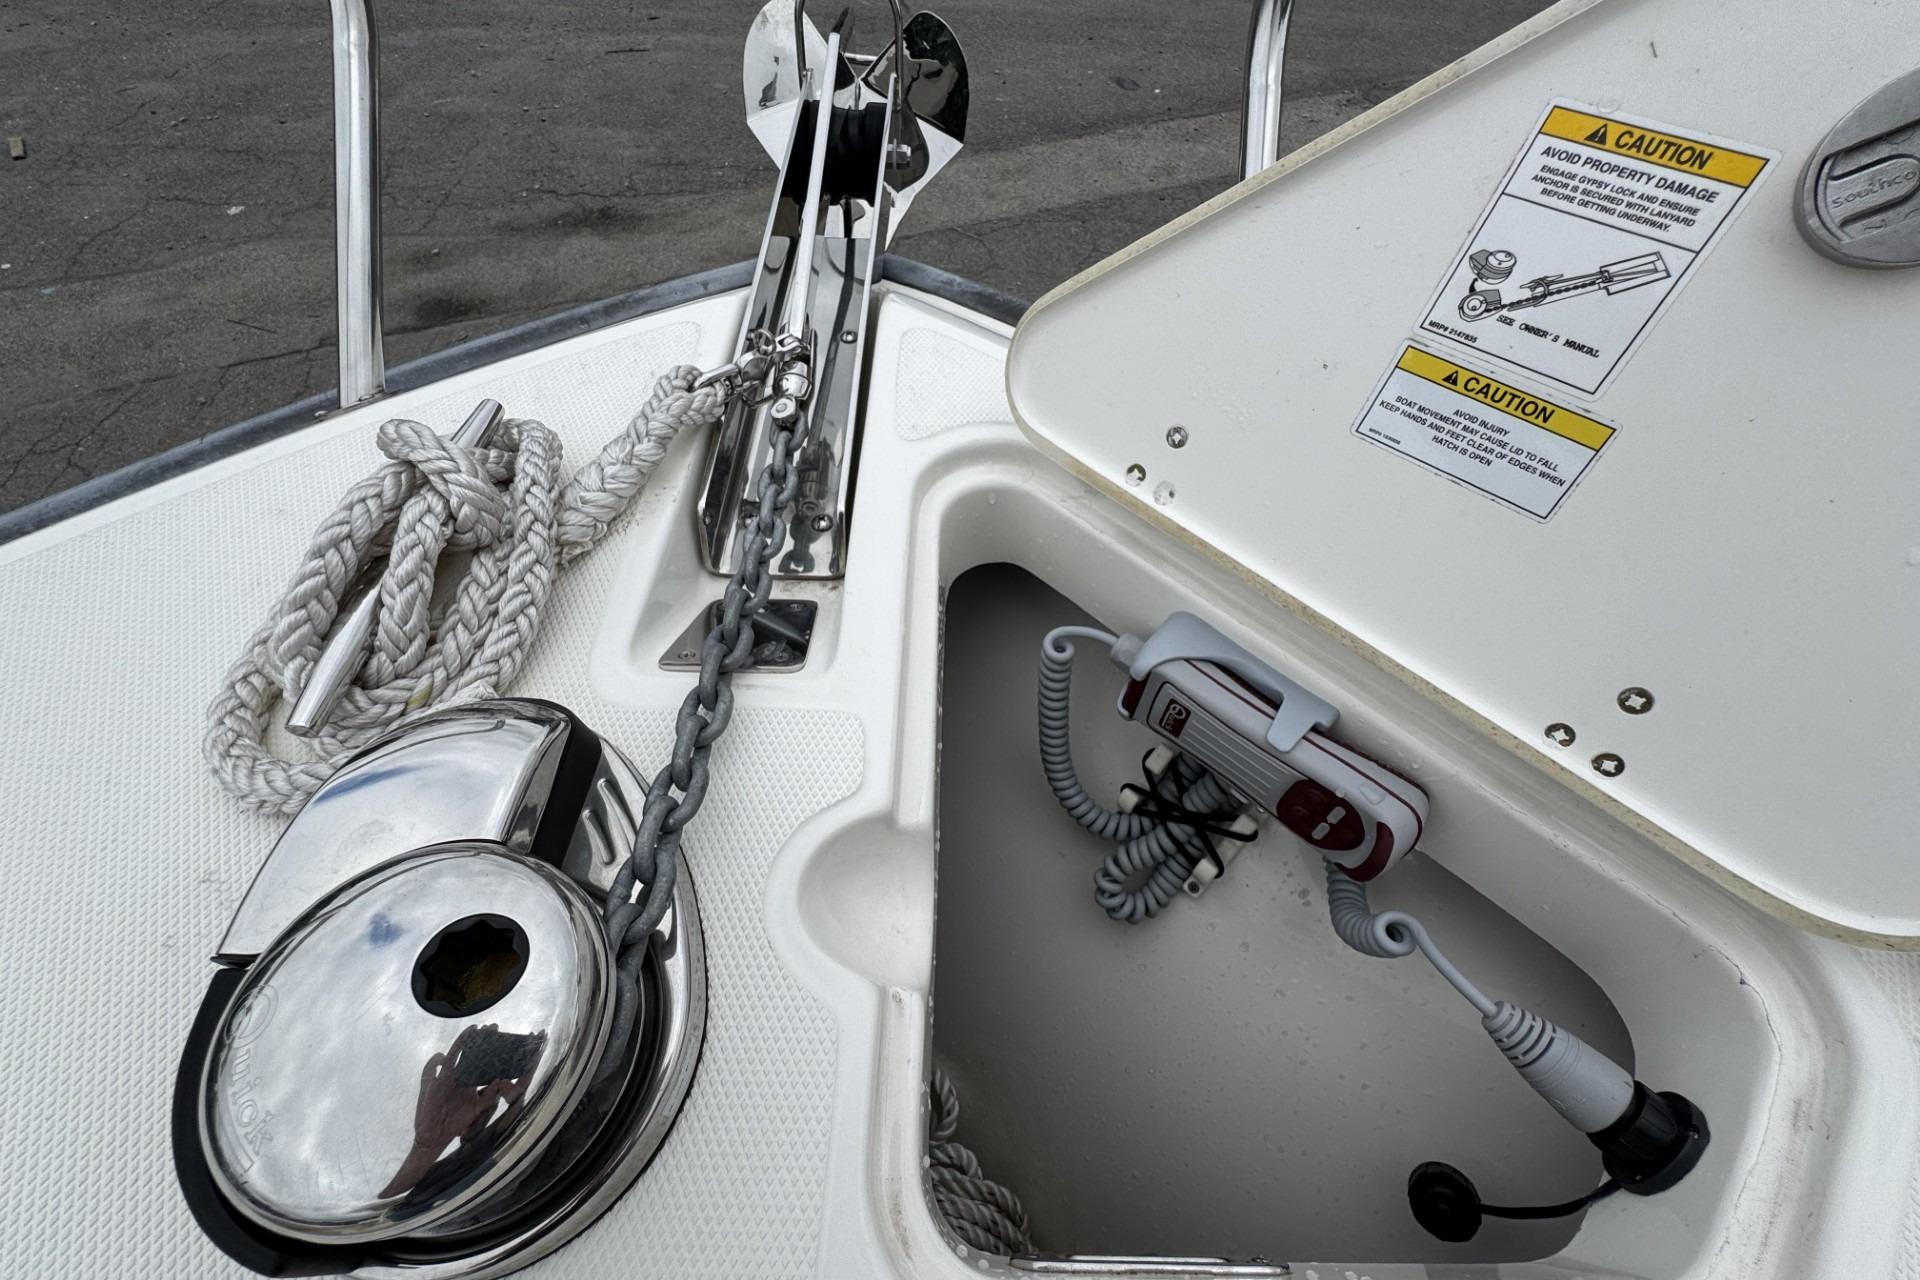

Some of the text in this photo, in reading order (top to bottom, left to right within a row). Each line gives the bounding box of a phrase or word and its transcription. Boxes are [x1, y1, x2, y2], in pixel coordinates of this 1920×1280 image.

[1541, 146, 1720, 203] AVOID PROPERTY DAMAGE
[1615, 130, 1714, 170] CAUTION
[1531, 174, 1696, 227] ANCHOR IS SECURED WITH LANYARD
[1540, 164, 1701, 216] ENGAGE GYPSY LOCK AND ENSURE
[1540, 187, 1672, 232] BEFORE GETTING UNDERWAY.
[1496, 314, 1600, 358] SEE OWNER'S MANUAL
[1453, 409, 1510, 437] AVOID INJURY
[1464, 377, 1555, 424] CAUTION
[1379, 399, 1566, 487] KEEP HANDS AND FEET CLEAR OF EDGES WHEN
[1395, 395, 1559, 472] BOAT MOVEMENT MAY CAUSE LID TO FALL
[1431, 434, 1493, 467] HATCH IS OPEN
[225, 984, 279, 1157] Quick
